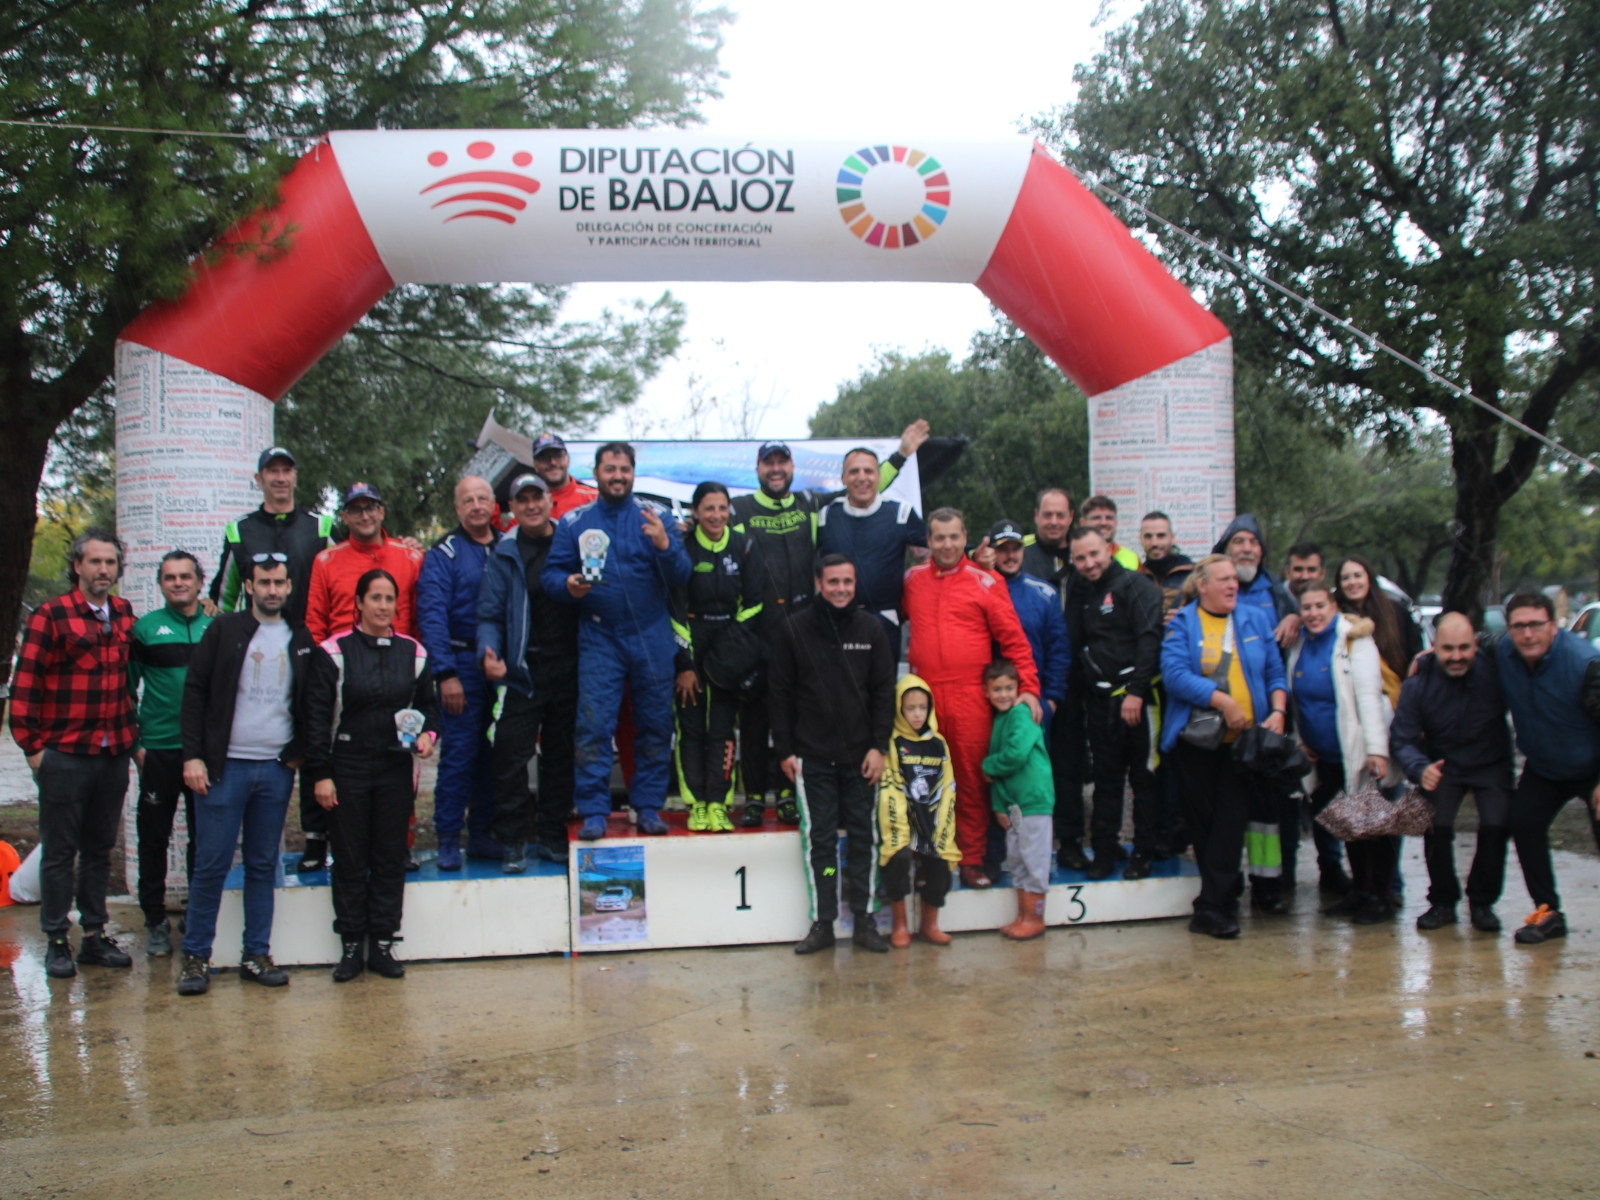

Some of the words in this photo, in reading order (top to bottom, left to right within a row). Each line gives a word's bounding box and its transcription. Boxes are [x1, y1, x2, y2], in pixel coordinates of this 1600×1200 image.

[559, 142, 795, 175] DIPUTACIÓN
[559, 186, 596, 212] DE
[609, 178, 795, 214] BADAJOZ
[576, 221, 654, 233] DELEGACIÓN
[657, 222, 672, 233] DE
[675, 222, 773, 236] CONCERTACIÓN
[588, 237, 594, 245] Y
[598, 236, 690, 246] PARTICIPACIÓN
[693, 237, 762, 247] TERRITORIAL
[166, 377, 211, 388] Olivenza
[218, 407, 242, 420] Feria
[166, 496, 207, 508] Siruela
[735, 866, 752, 911] 1
[1068, 885, 1087, 922] 3
